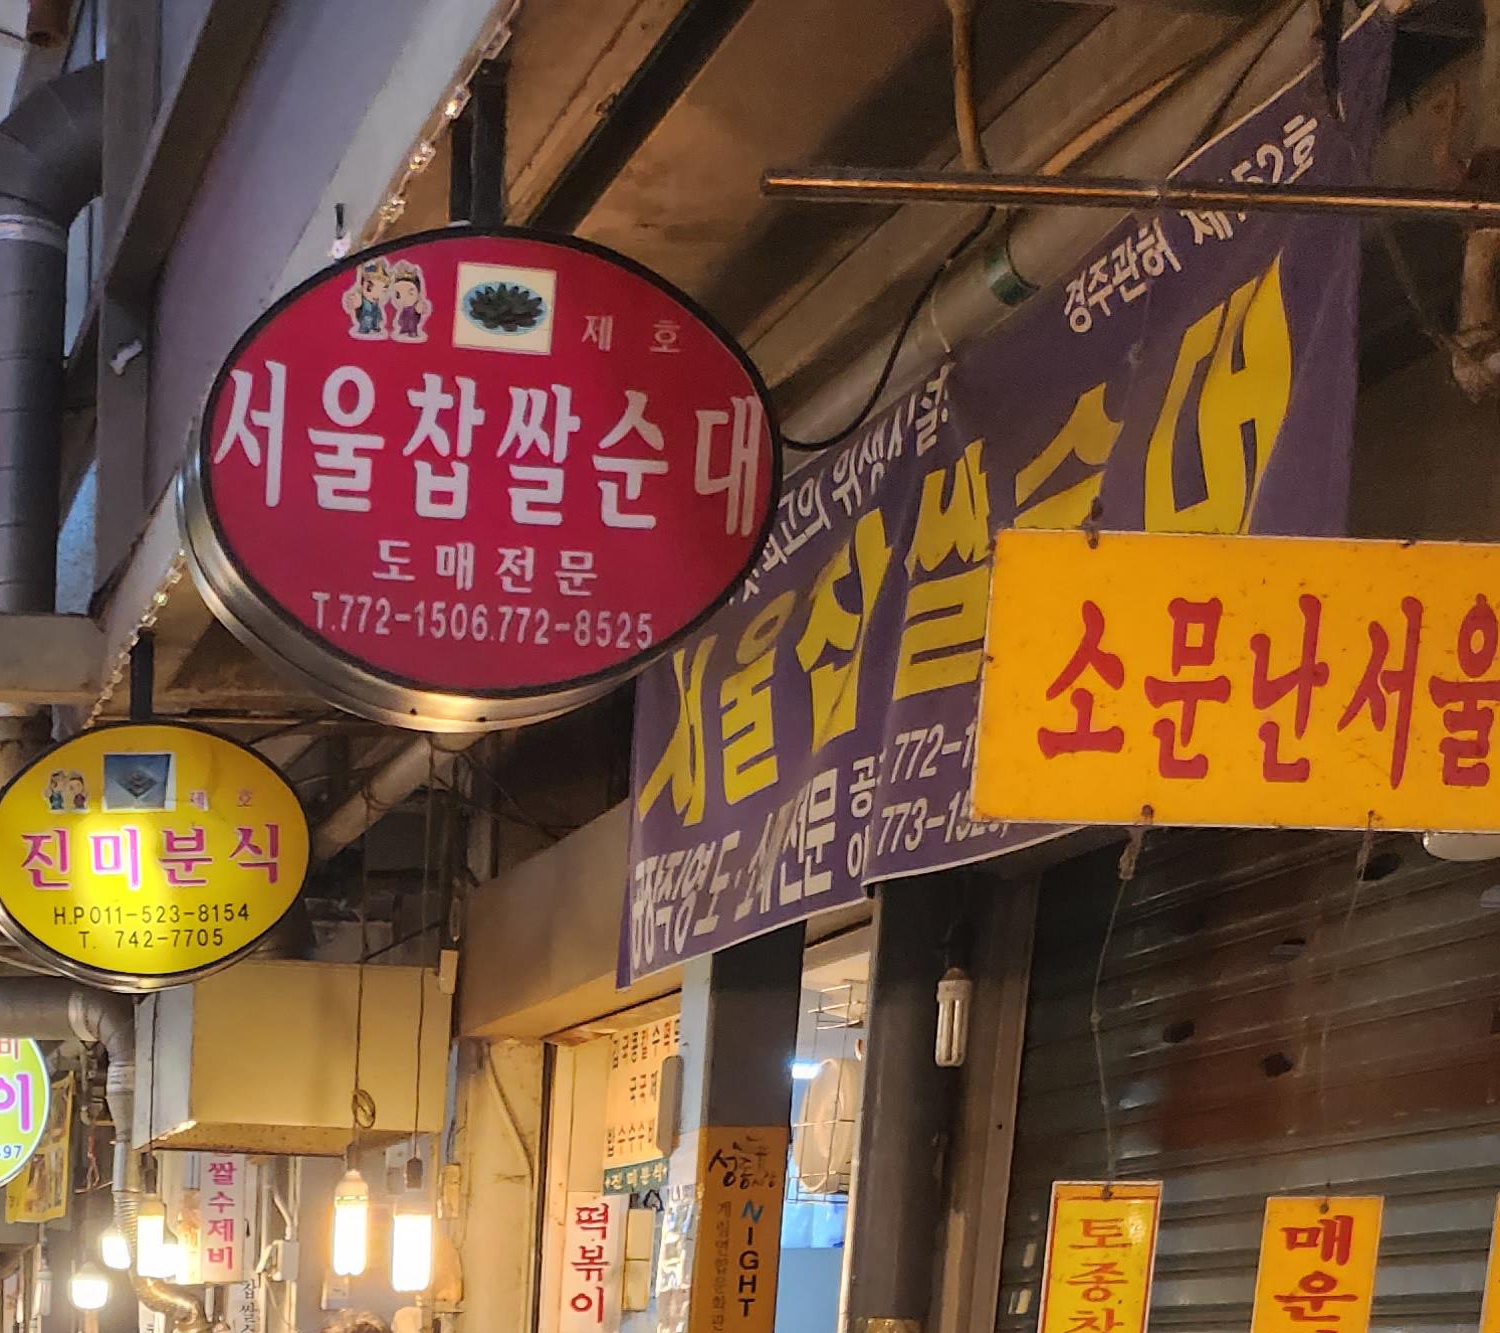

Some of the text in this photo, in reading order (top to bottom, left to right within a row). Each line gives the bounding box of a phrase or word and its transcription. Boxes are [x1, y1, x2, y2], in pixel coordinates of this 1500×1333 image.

[1064, 216, 1182, 333] 경주관허
[582, 314, 681, 354] 제 호
[213, 358, 763, 536] 서울찹쌀순대
[372, 539, 600, 597] 도매전문
[20, 823, 280, 891] 진미분식
[115, 927, 224, 949] 742-7705
[207, 1154, 238, 1270] 쌀수제비
[570, 1203, 611, 1324] 떡볶이
[738, 1199, 764, 1318] NIGHT
